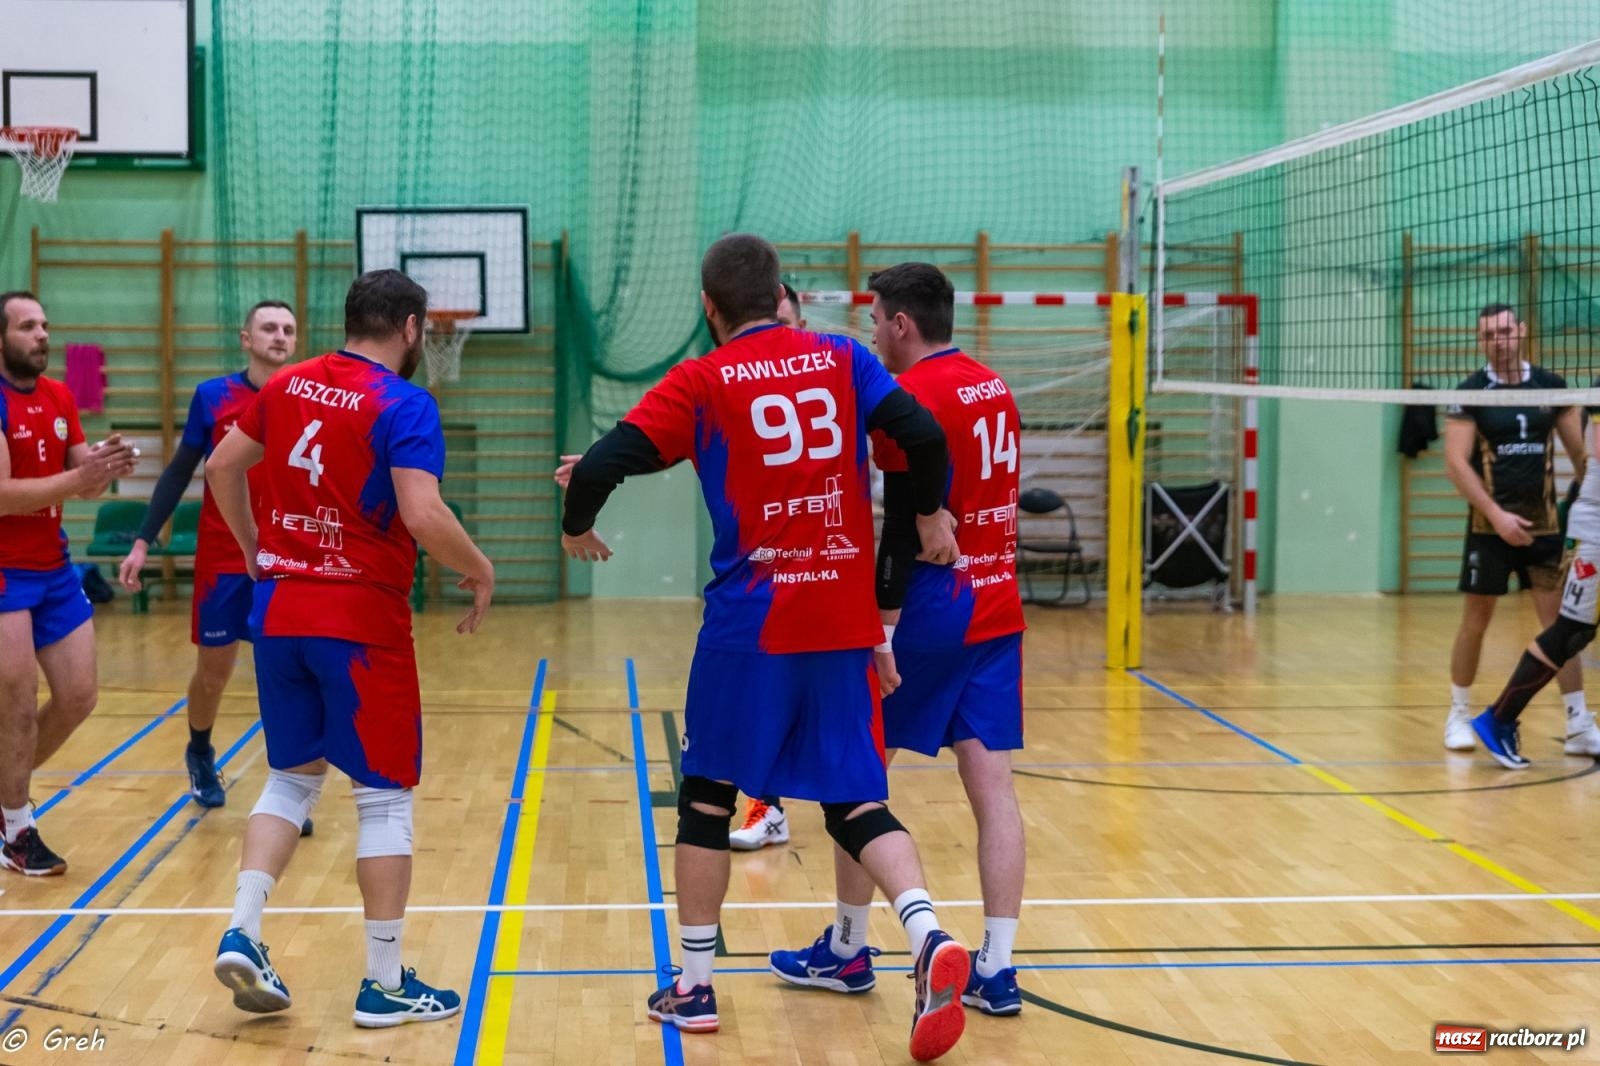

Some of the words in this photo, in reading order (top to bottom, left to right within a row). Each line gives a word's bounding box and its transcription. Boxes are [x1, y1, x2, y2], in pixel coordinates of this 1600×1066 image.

[720, 350, 837, 384] PAWLICZEK
[285, 376, 365, 411] JUSZCZYK
[956, 377, 1007, 405] GRYSKO
[750, 387, 843, 466] 93
[1516, 414, 1528, 439] 1
[288, 419, 324, 487] 4
[973, 411, 1018, 480] 14
